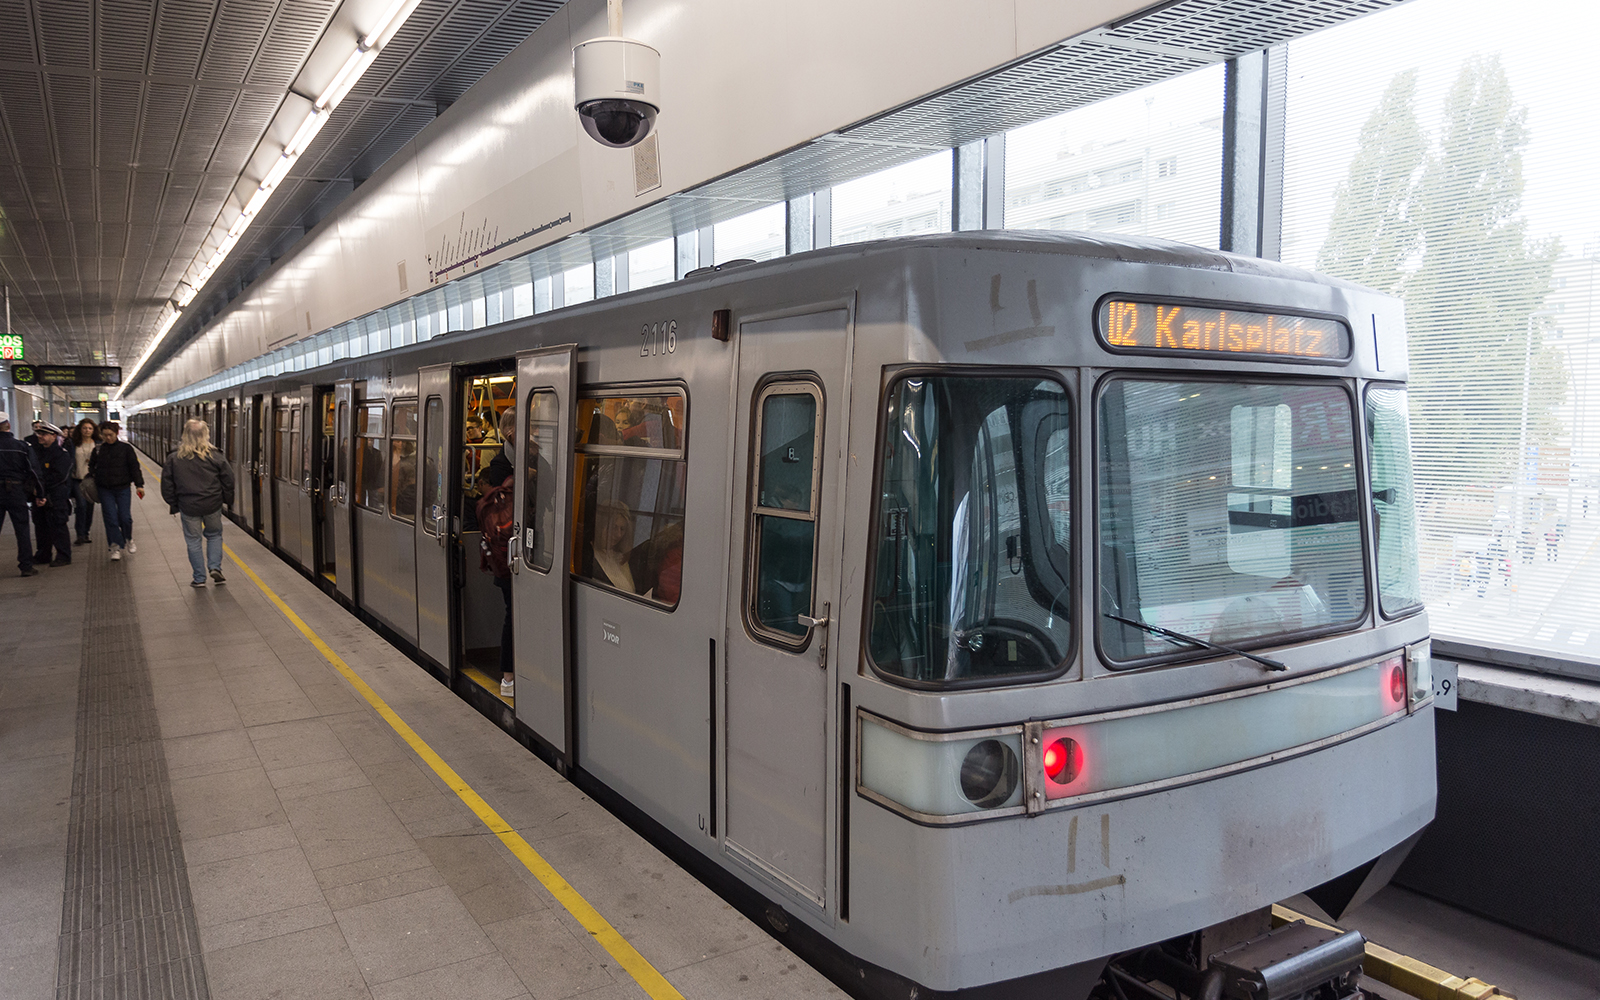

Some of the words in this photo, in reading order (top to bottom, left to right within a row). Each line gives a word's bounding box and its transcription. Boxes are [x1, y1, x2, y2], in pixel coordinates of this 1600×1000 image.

[0, 335, 23, 346] OS
[640, 319, 677, 357] 2116
[1107, 301, 1138, 346] U2
[1155, 305, 1323, 358] Karlsplatz
